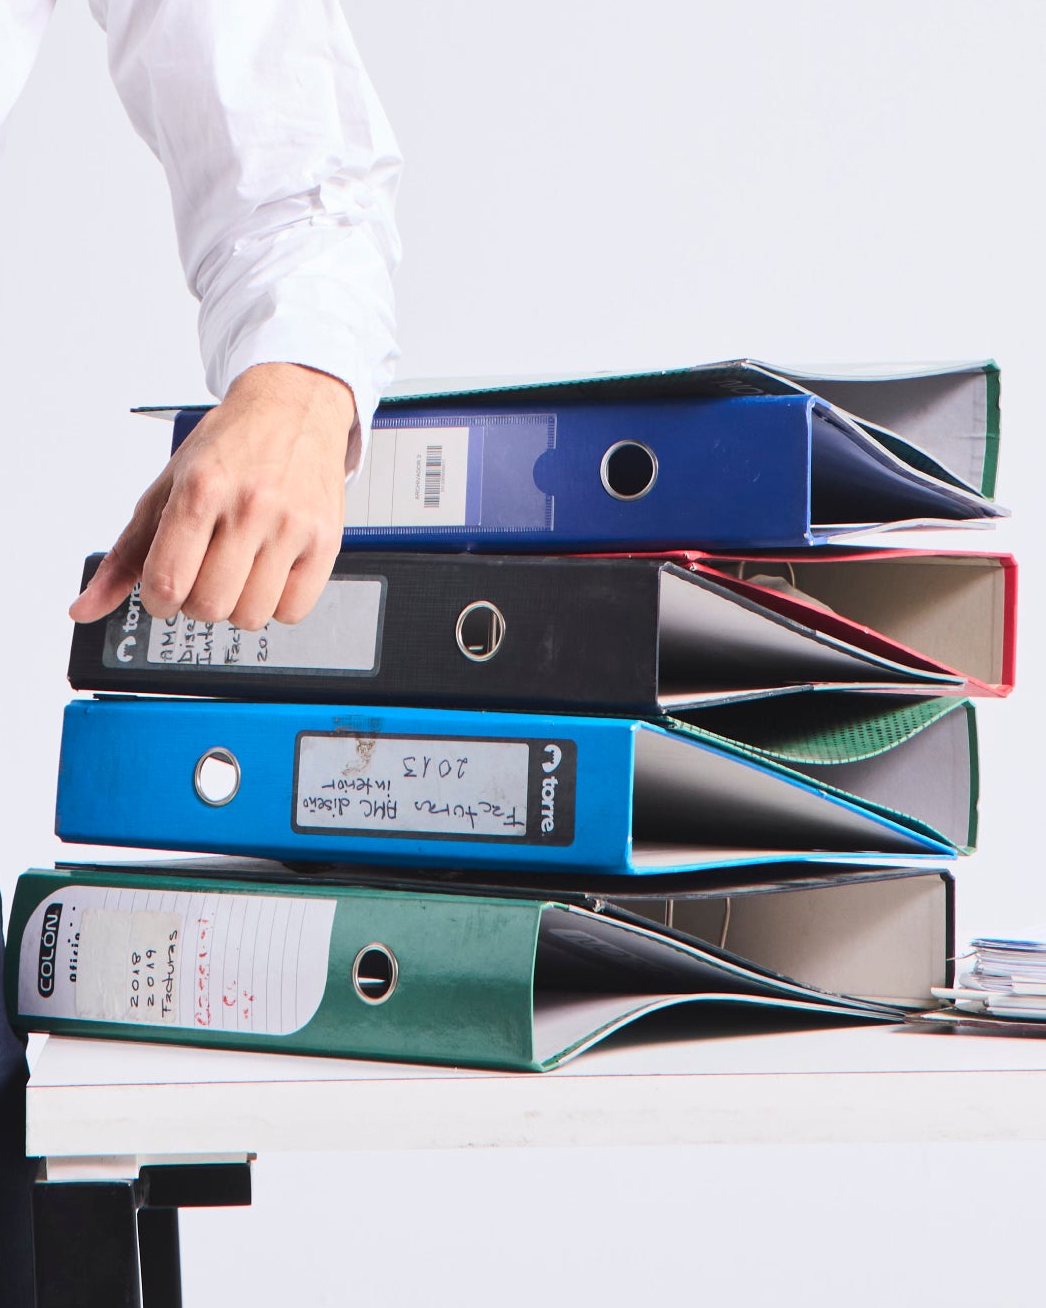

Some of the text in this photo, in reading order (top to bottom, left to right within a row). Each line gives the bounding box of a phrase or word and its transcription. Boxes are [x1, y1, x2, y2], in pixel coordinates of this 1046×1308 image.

[197, 622, 214, 665] Inte
[224, 627, 241, 663] Fact
[322, 777, 392, 798] interior
[403, 756, 469, 779] 2013
[303, 796, 525, 829] Facturas AMC diseño
[541, 776, 562, 833] torre
[40, 914, 59, 991] COLÓN
[161, 929, 178, 1018] Facturas
[130, 952, 142, 1008] 2018
[146, 949, 157, 1007] 2019
